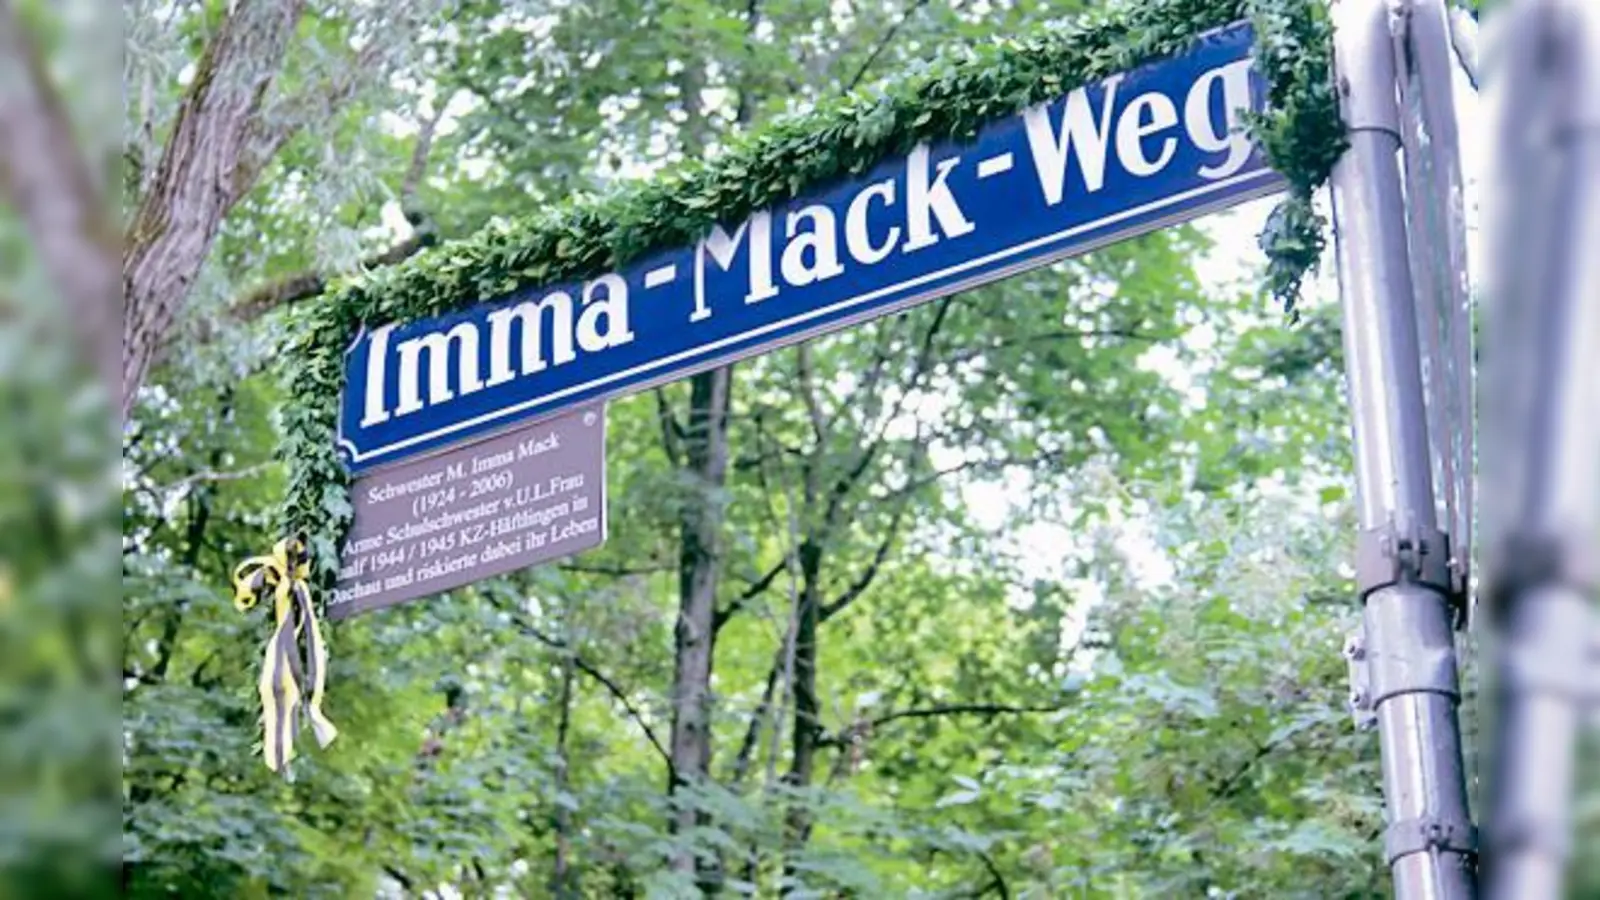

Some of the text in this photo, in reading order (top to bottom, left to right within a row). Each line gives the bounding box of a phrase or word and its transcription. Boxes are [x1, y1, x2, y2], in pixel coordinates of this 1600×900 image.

[360, 58, 1256, 428] Imma-Mack-Weg
[367, 431, 560, 504] Schwester M. Imma Mack
[412, 486, 456, 519] (1924
[469, 469, 514, 499] 2006)
[337, 556, 369, 581] alf
[371, 547, 405, 572] 1944
[419, 532, 456, 559] 1945
[459, 502, 569, 548] KZ-Häftlingen
[571, 494, 588, 513] in
[341, 534, 383, 558] Arme
[386, 500, 500, 545] Schulschwester
[384, 566, 414, 591] und
[416, 553, 478, 582] riskierte
[480, 535, 521, 563] dabei
[526, 530, 548, 551] ihr
[550, 517, 599, 543] Leben
